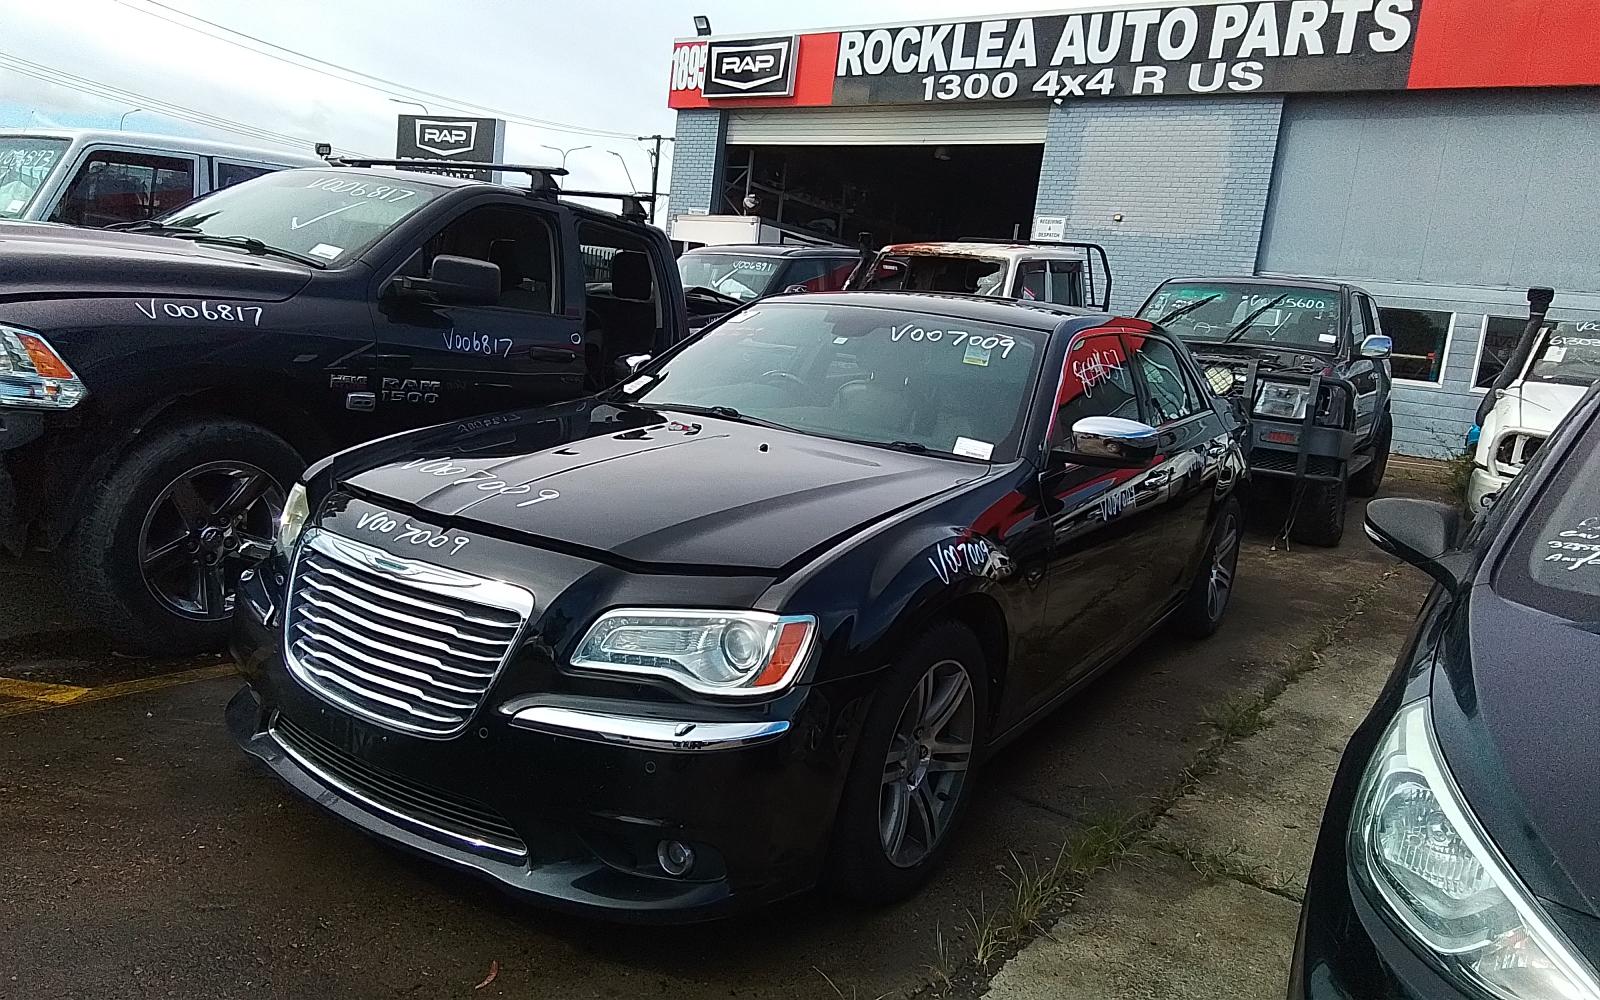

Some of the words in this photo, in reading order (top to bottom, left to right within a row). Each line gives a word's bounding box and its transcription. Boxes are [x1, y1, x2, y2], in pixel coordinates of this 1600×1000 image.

[837, 19, 1037, 77] ROCKLEA
[1050, 7, 1200, 67] AUTO
[1207, 0, 1414, 59] PARTS
[721, 54, 775, 75] RAP
[921, 71, 1019, 102] 1300
[1032, 67, 1116, 97] 4x4
[1132, 65, 1168, 95] R
[1187, 60, 1265, 93] US
[424, 128, 467, 144] RAP
[305, 177, 416, 203] V006817
[135, 298, 263, 327] V006817
[442, 327, 513, 358] V006817
[890, 324, 1016, 359] V007009
[400, 457, 560, 508] V007009
[356, 511, 470, 556] V007009
[928, 540, 990, 585] V007009
